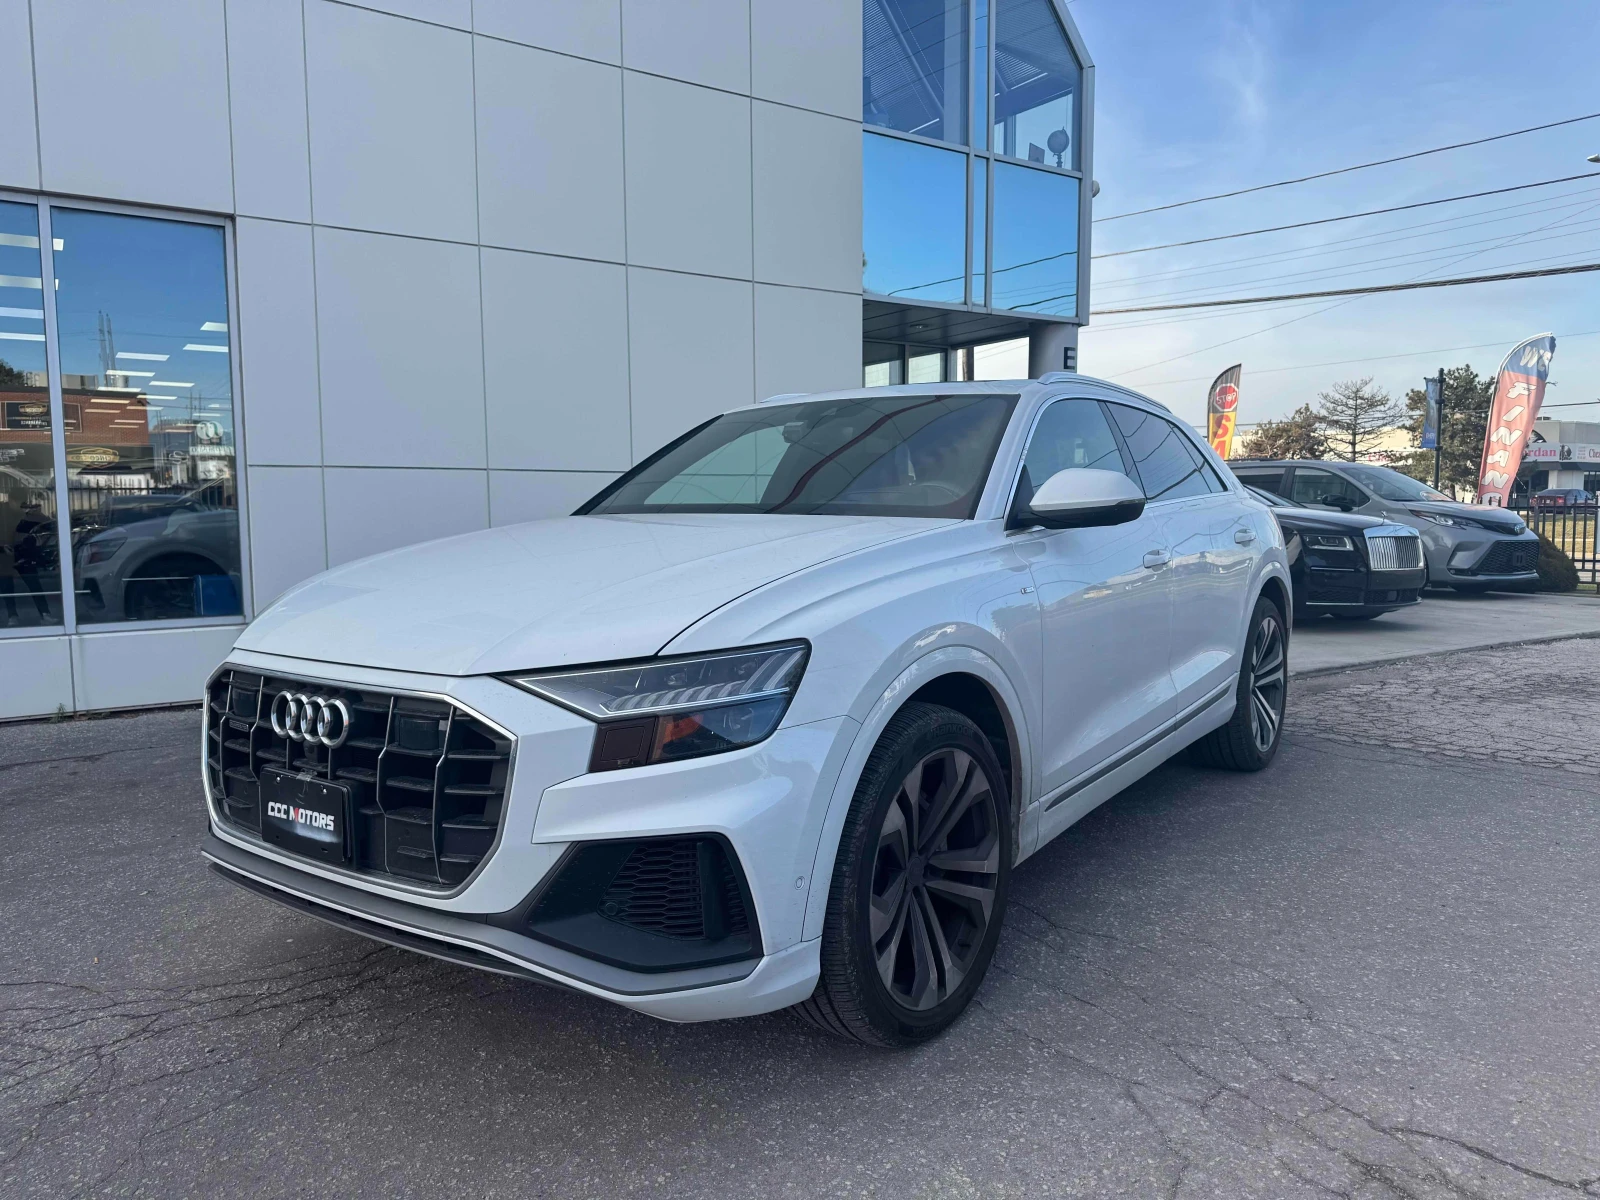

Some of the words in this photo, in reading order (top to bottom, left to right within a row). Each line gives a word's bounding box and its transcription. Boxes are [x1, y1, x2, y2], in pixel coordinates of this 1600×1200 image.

[1216, 393, 1237, 405] STOP
[267, 801, 288, 819] CCC
[289, 805, 335, 831] MOTORS
